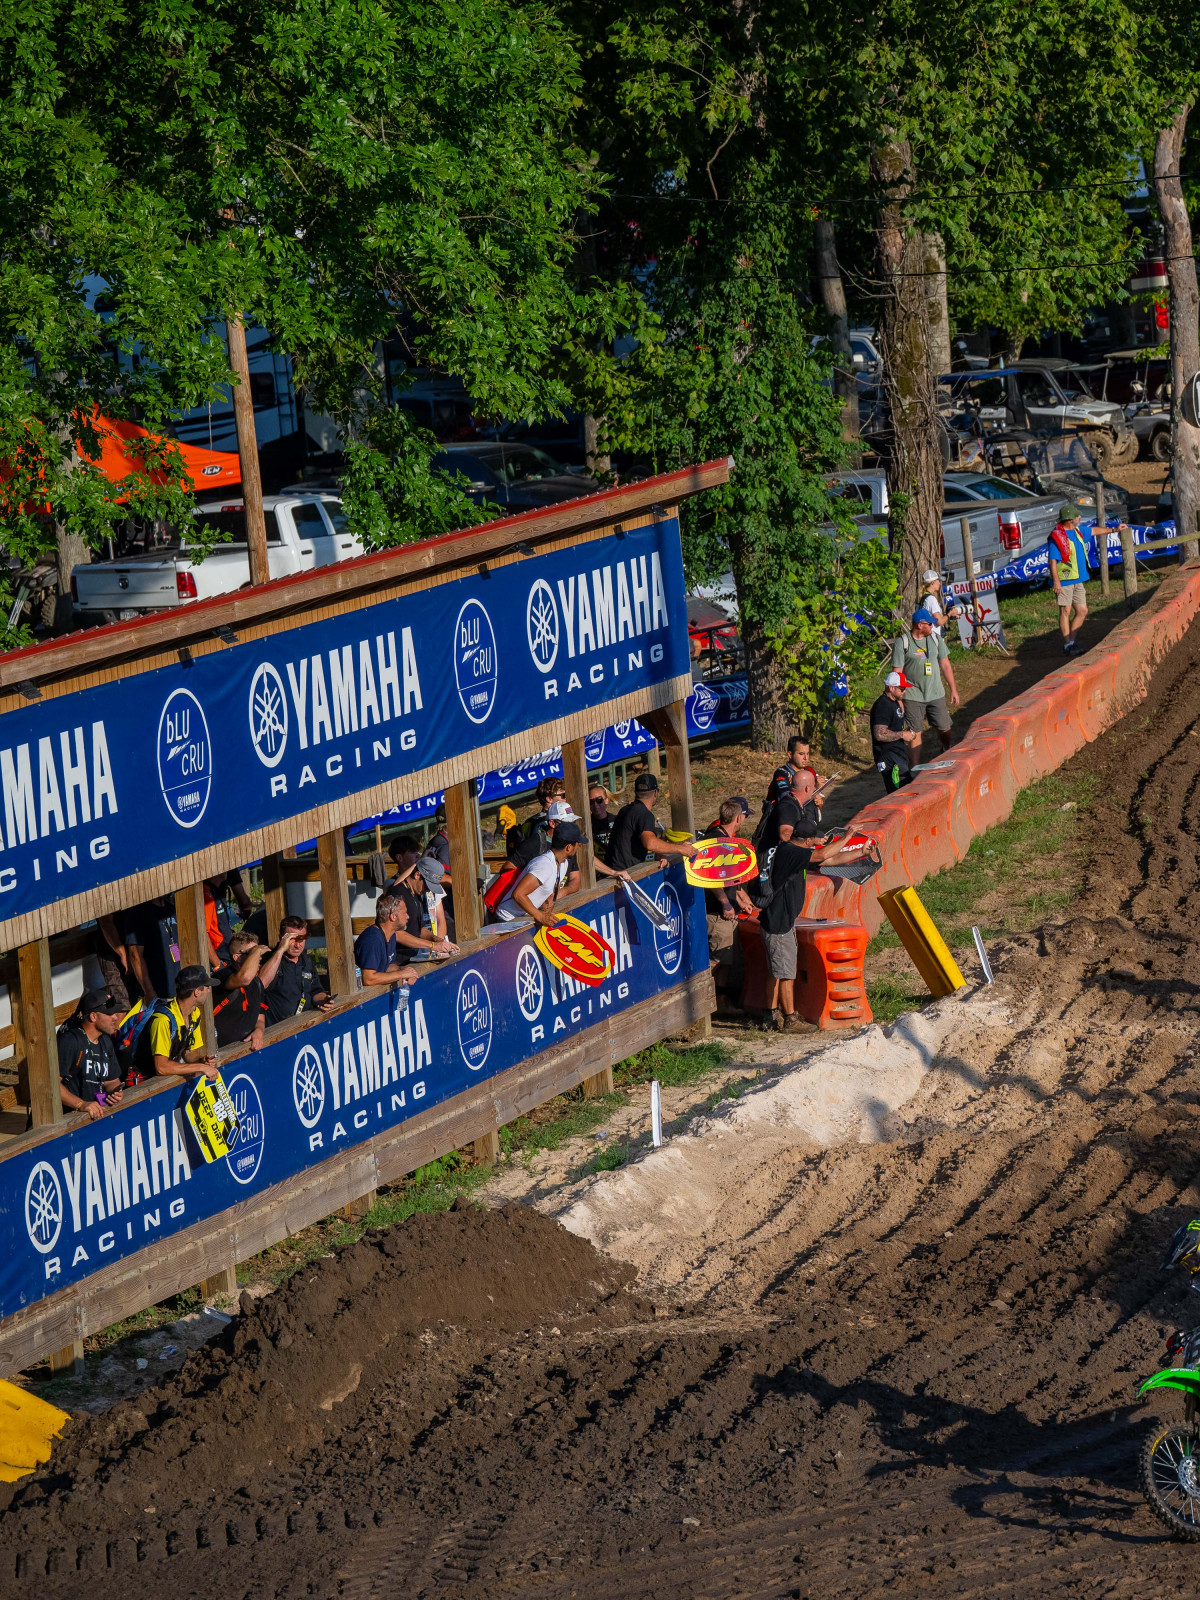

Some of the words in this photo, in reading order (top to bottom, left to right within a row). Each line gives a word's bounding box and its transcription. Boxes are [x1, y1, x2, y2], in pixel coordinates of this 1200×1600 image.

[557, 551, 669, 659] YAMAHA
[953, 580, 993, 595] CAUION
[286, 626, 424, 750] YAMAHA
[544, 643, 664, 700] RACING
[0, 720, 118, 851] MAHA
[270, 728, 417, 798] RACING
[502, 762, 561, 788] RACIN
[691, 853, 748, 872] FMF
[547, 928, 605, 968] FMF
[531, 982, 630, 1043] RACING
[85, 1060, 109, 1077] FOX
[323, 999, 432, 1111] YAMAHA
[199, 1091, 214, 1119] DEEP
[212, 1099, 228, 1122] 188
[309, 1081, 426, 1152] RACING
[61, 1113, 192, 1233] YAMAHA
[45, 1197, 186, 1279] RACING
